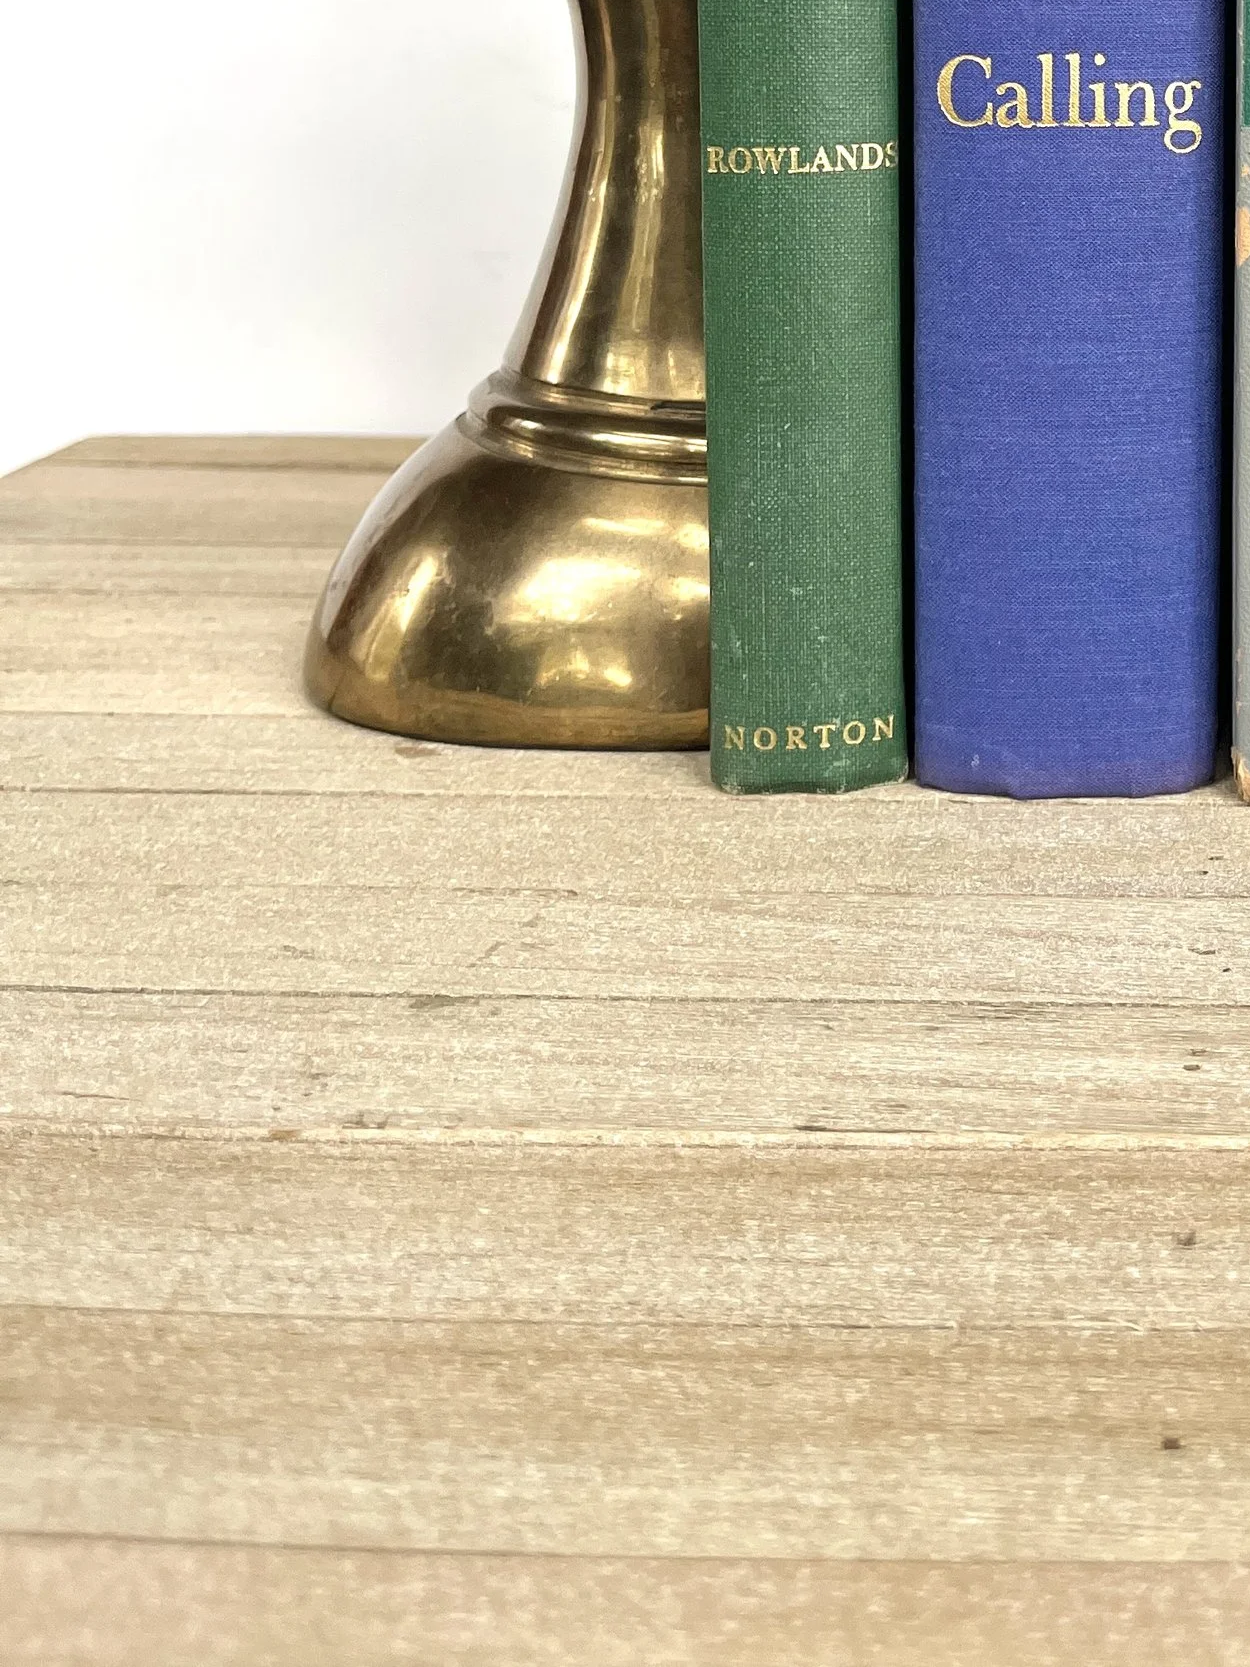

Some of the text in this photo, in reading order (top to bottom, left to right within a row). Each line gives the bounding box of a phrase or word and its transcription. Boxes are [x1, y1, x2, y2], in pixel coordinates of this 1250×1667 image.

[937, 52, 1203, 155] Calling
[706, 141, 898, 175] ROWLANDS
[723, 713, 895, 751] NORTON
